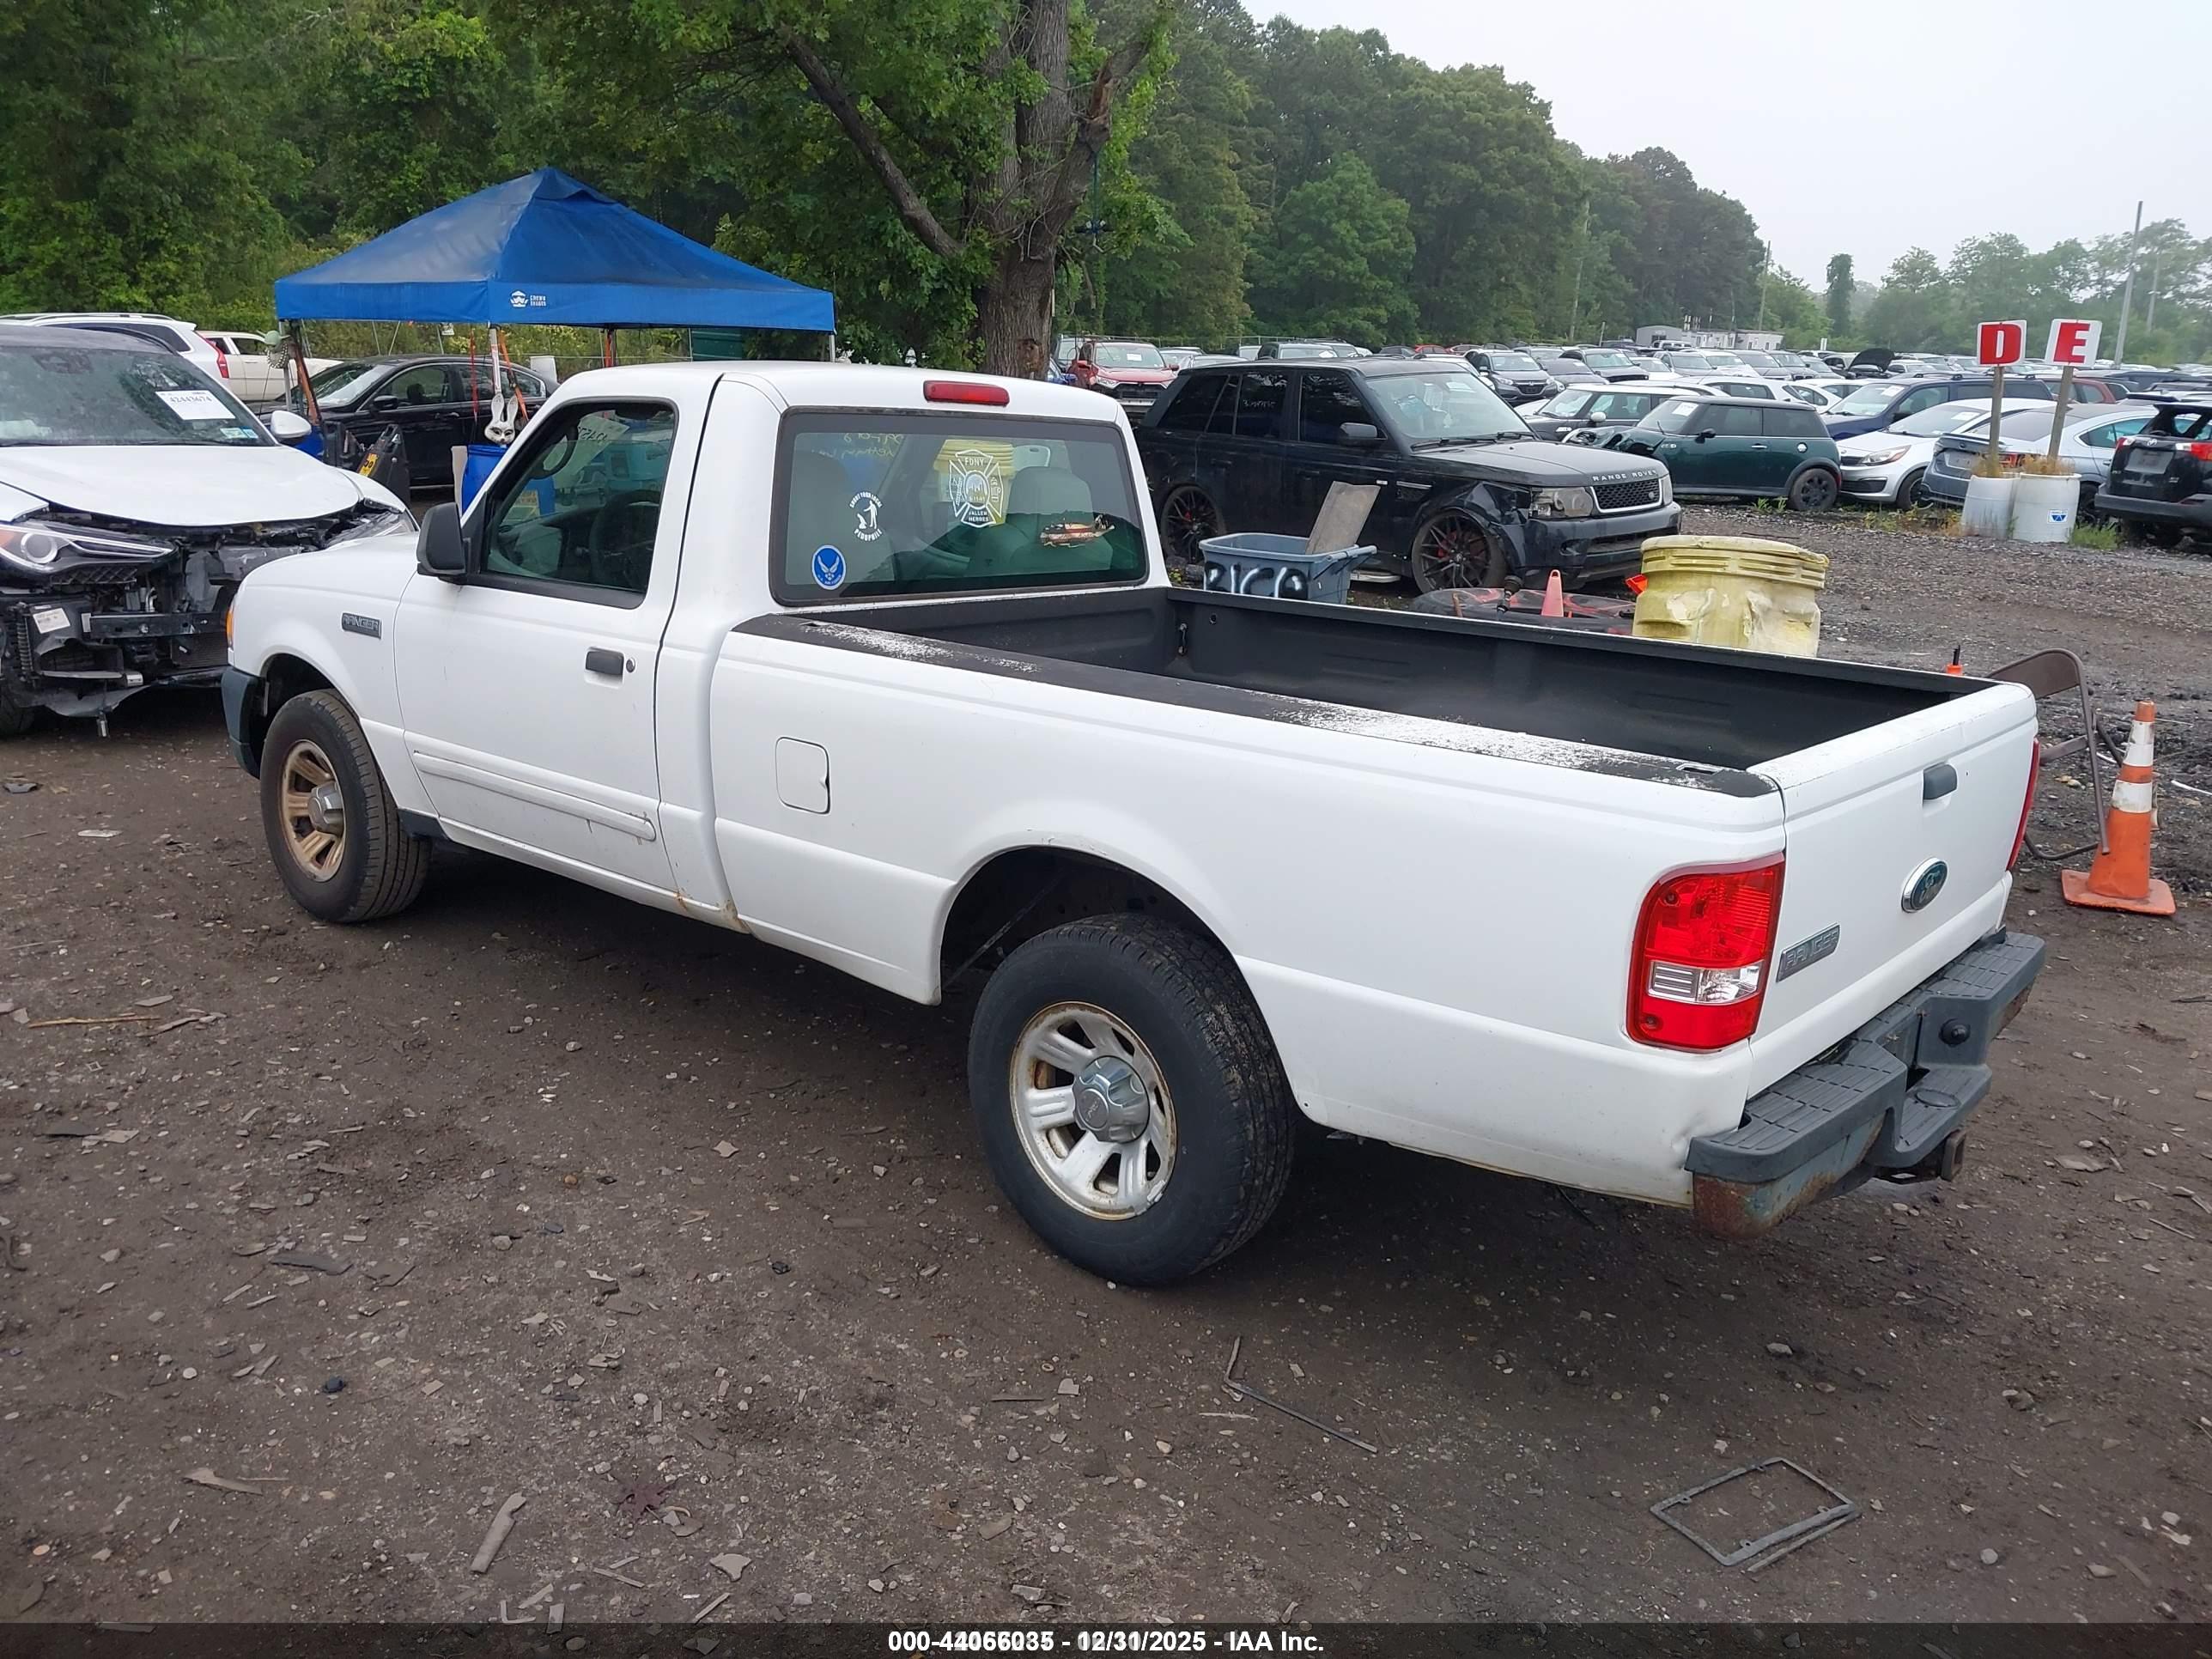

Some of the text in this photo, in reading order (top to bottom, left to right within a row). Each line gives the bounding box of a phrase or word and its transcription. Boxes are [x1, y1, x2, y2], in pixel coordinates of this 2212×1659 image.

[1980, 324, 2021, 365] D
[2053, 322, 2091, 363] E
[965, 457, 984, 465] FDNY
[1592, 473, 1627, 482] RANGE
[854, 528, 883, 542] PEDOPHILE
[343, 613, 380, 631] RANGER
[1784, 928, 1838, 970] RANGER
